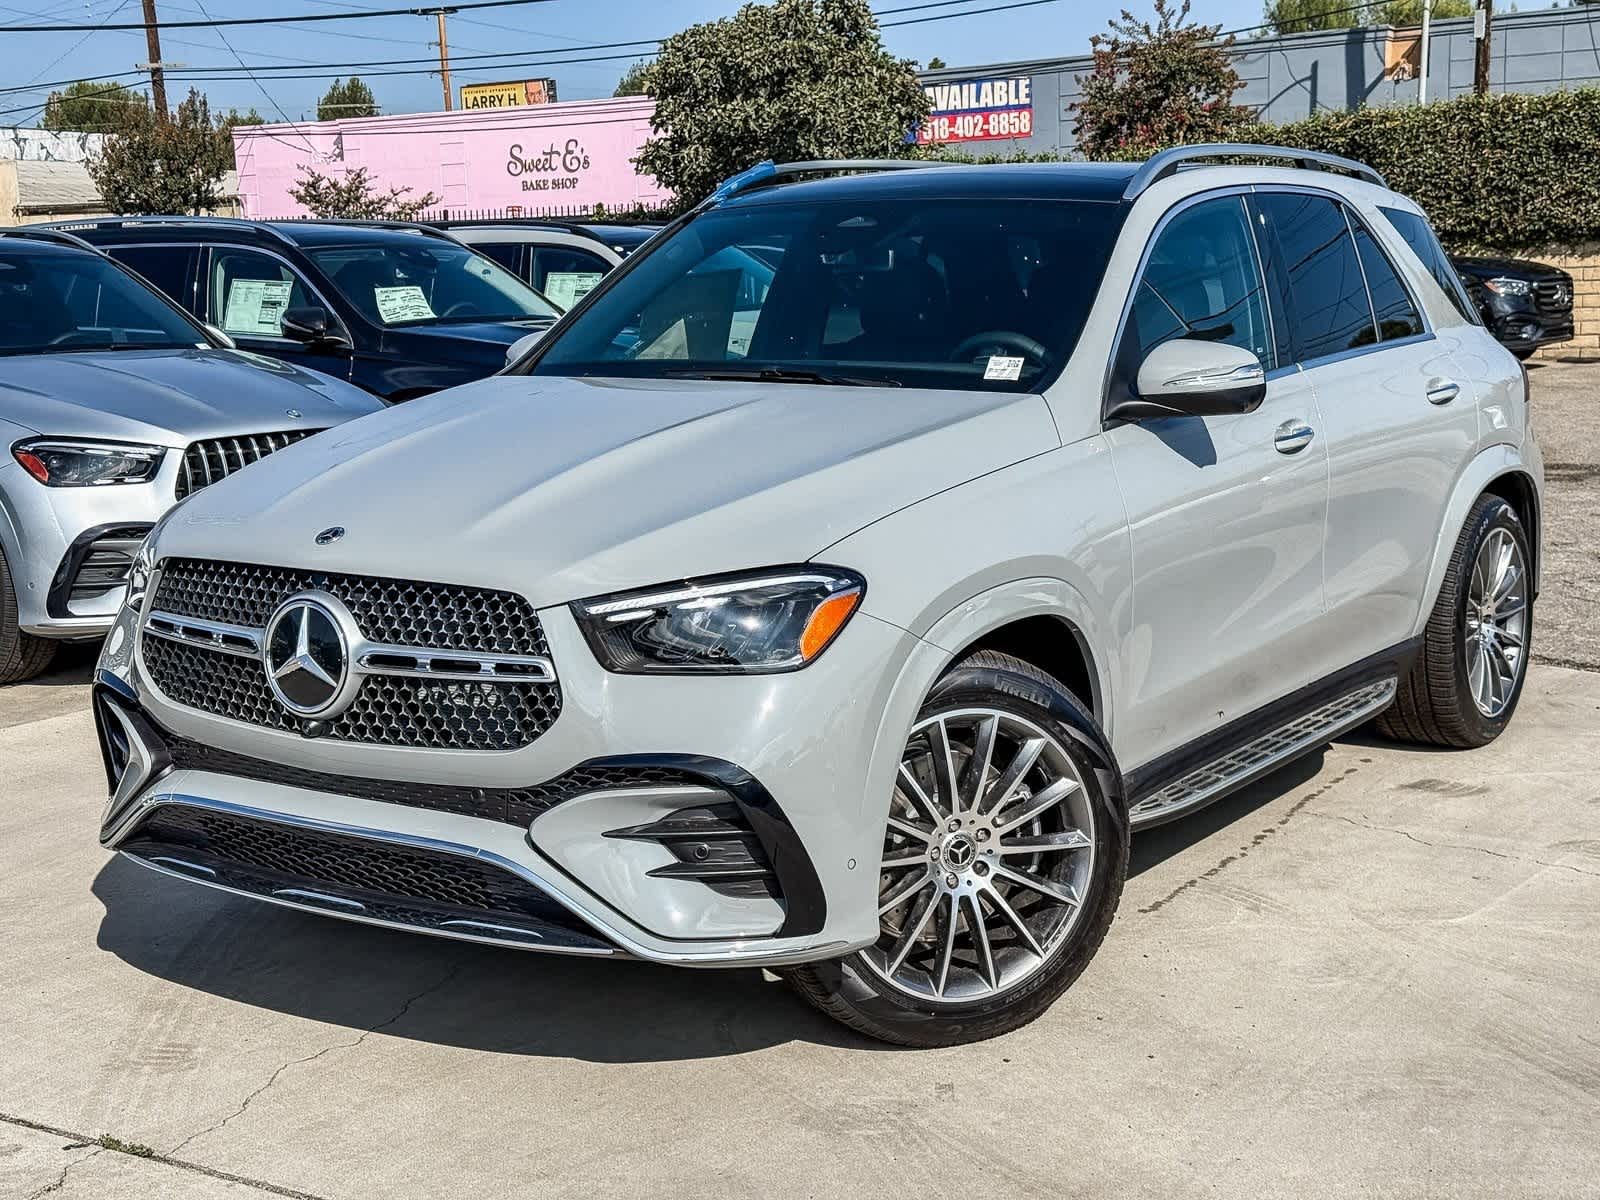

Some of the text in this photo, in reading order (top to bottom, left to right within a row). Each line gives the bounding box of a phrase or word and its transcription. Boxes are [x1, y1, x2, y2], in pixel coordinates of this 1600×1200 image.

[464, 92, 520, 109] LARRY H.
[507, 138, 590, 177] Sweet E's
[522, 177, 579, 191] BAKE SHOP
